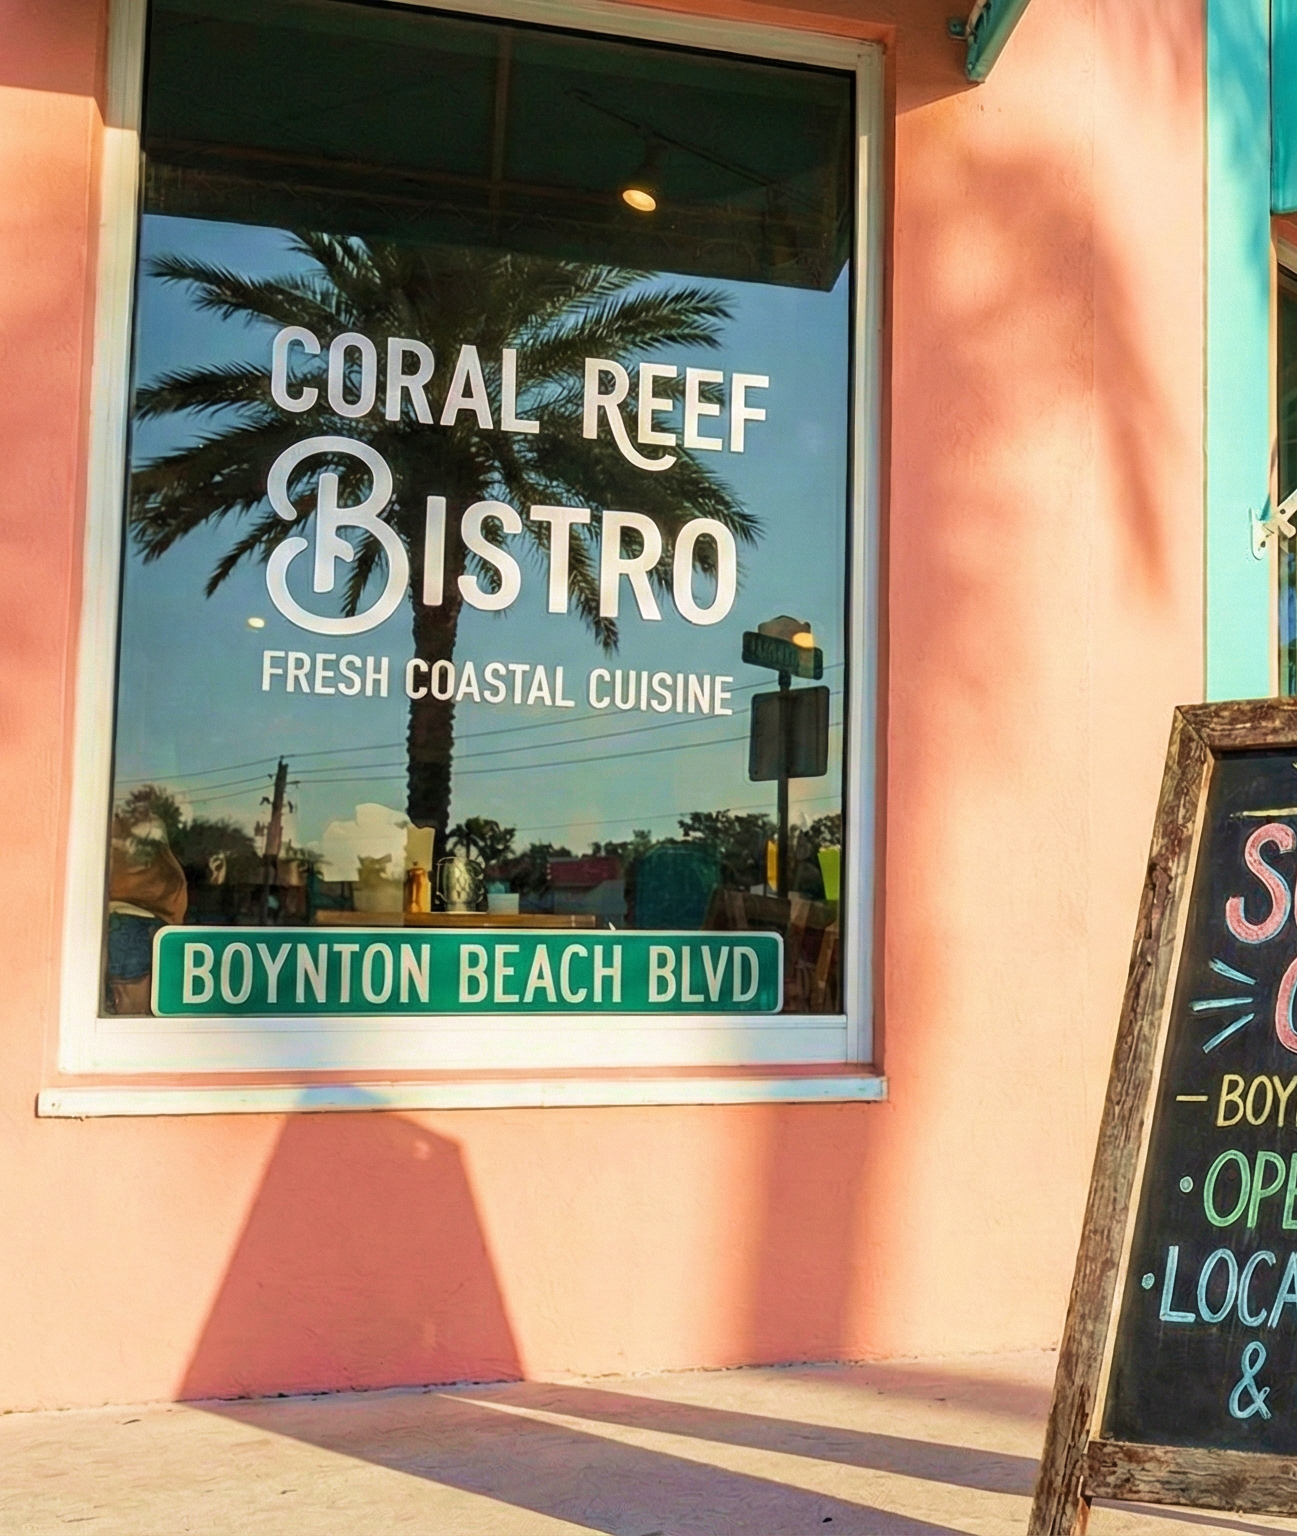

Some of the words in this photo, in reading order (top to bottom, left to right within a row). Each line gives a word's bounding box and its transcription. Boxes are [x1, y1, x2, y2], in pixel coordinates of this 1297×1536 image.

[271, 325, 540, 434] CORAL
[583, 358, 771, 471] REEF
[266, 436, 738, 635] BISTRO
[262, 650, 389, 697] FRESH
[406, 658, 575, 708] COASTAL
[589, 668, 734, 716] CUISINE
[182, 942, 430, 1004] BOYNTON
[458, 943, 622, 1004] BEACH
[649, 945, 761, 1003] BLVD
[1229, 1341, 1272, 1420] &
